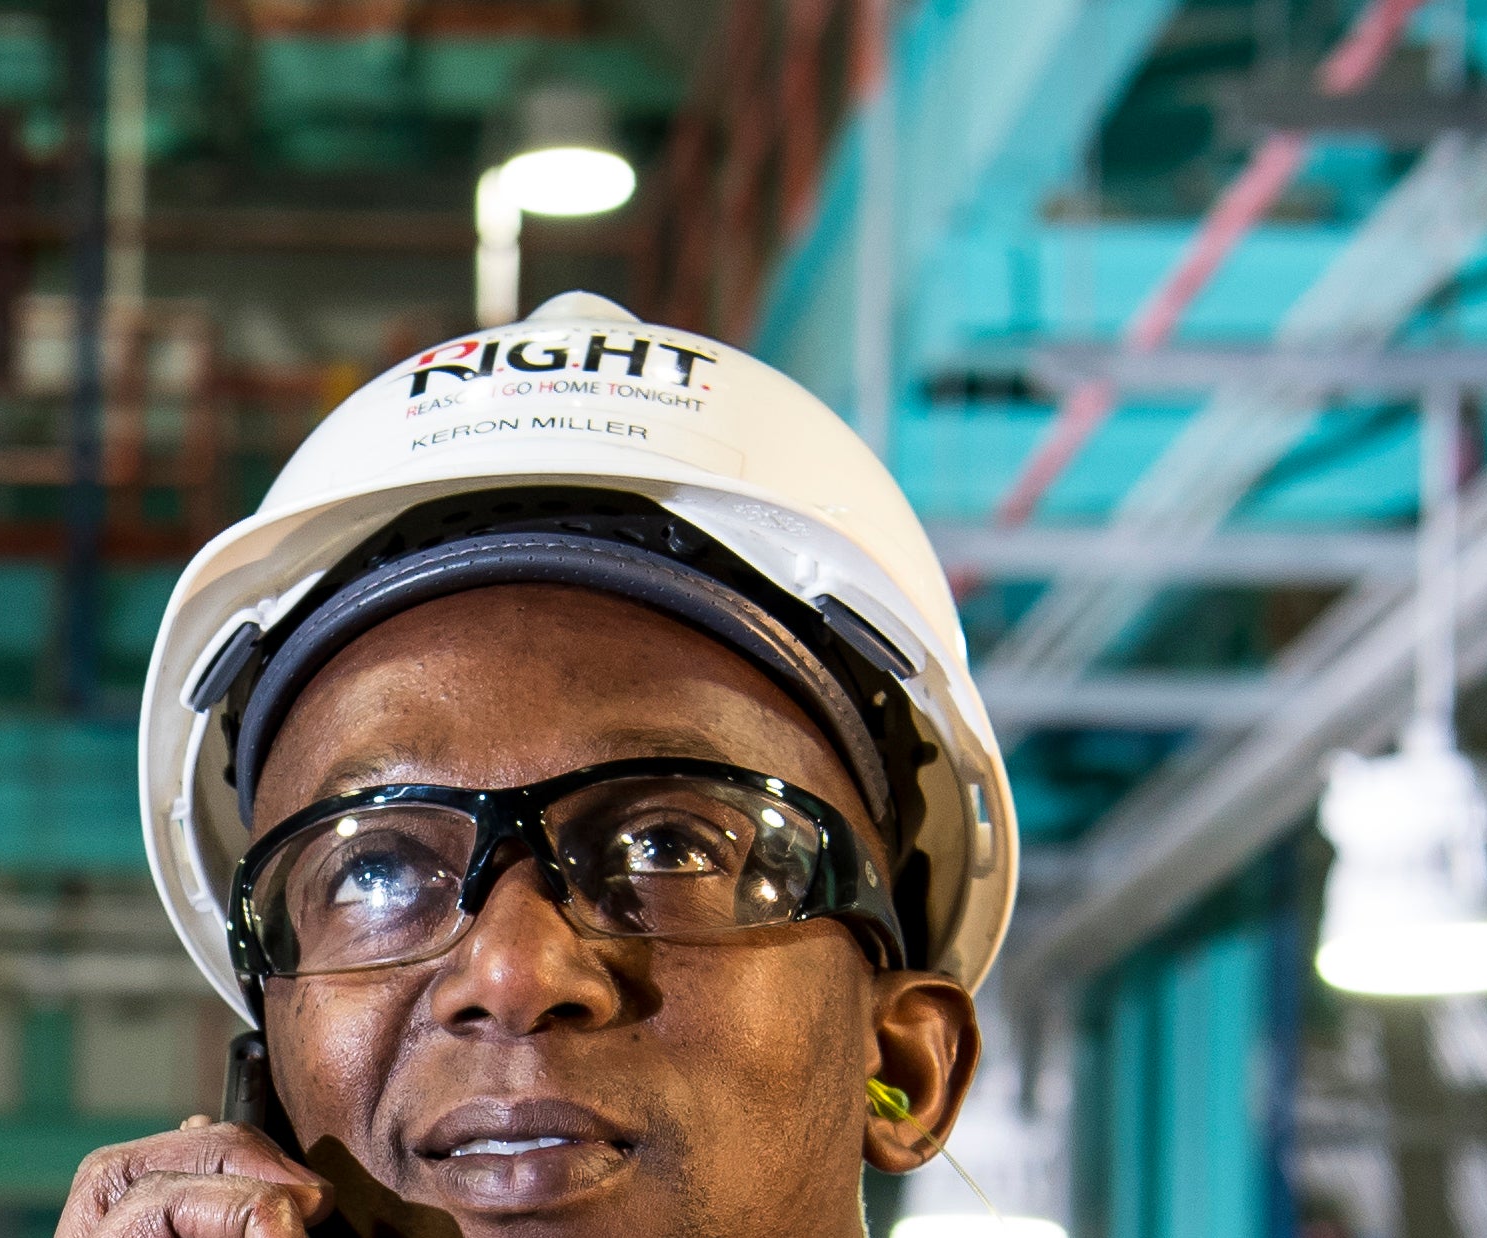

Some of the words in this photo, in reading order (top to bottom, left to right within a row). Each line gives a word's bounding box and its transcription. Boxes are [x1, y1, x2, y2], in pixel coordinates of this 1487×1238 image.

[502, 381, 532, 397] GO
[539, 380, 600, 396] HOME
[607, 382, 706, 414] TONIGHT
[411, 417, 519, 451] KERON
[531, 416, 647, 440] MILLER
